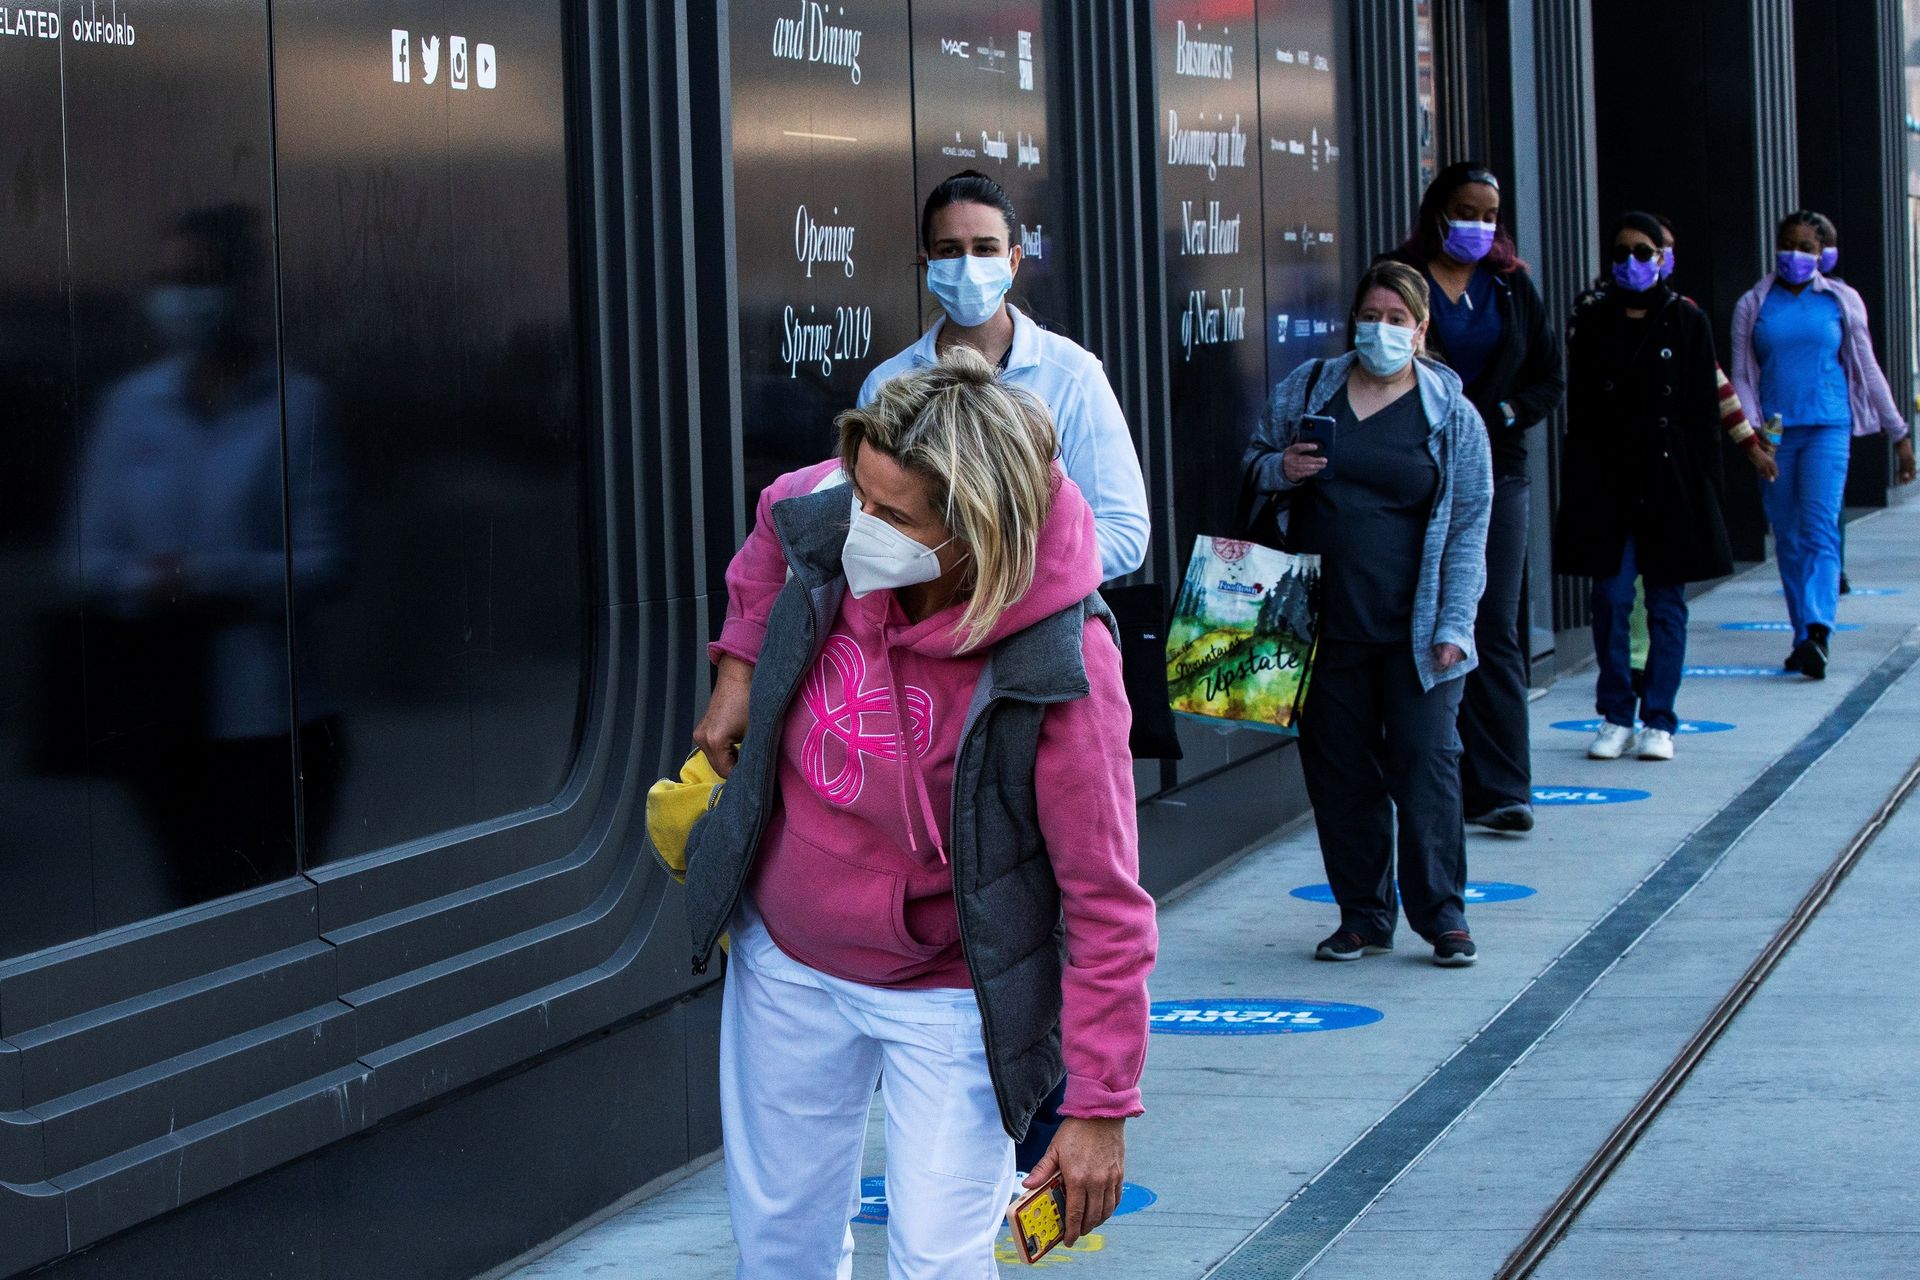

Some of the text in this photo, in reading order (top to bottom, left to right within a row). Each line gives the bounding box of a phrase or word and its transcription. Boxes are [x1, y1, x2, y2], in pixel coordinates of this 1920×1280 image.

[72, 18, 136, 46] OXFORD
[773, 0, 862, 85] and Dining
[941, 38, 970, 59] MAC
[1176, 20, 1233, 80] Business is
[1168, 109, 1246, 181] Booming in the
[795, 204, 855, 278] Opening
[1208, 200, 1241, 254] Heart
[782, 305, 872, 379] Spring 2019
[1181, 290, 1195, 362] of
[1221, 287, 1246, 342] York
[1198, 642, 1301, 702] Upstate
